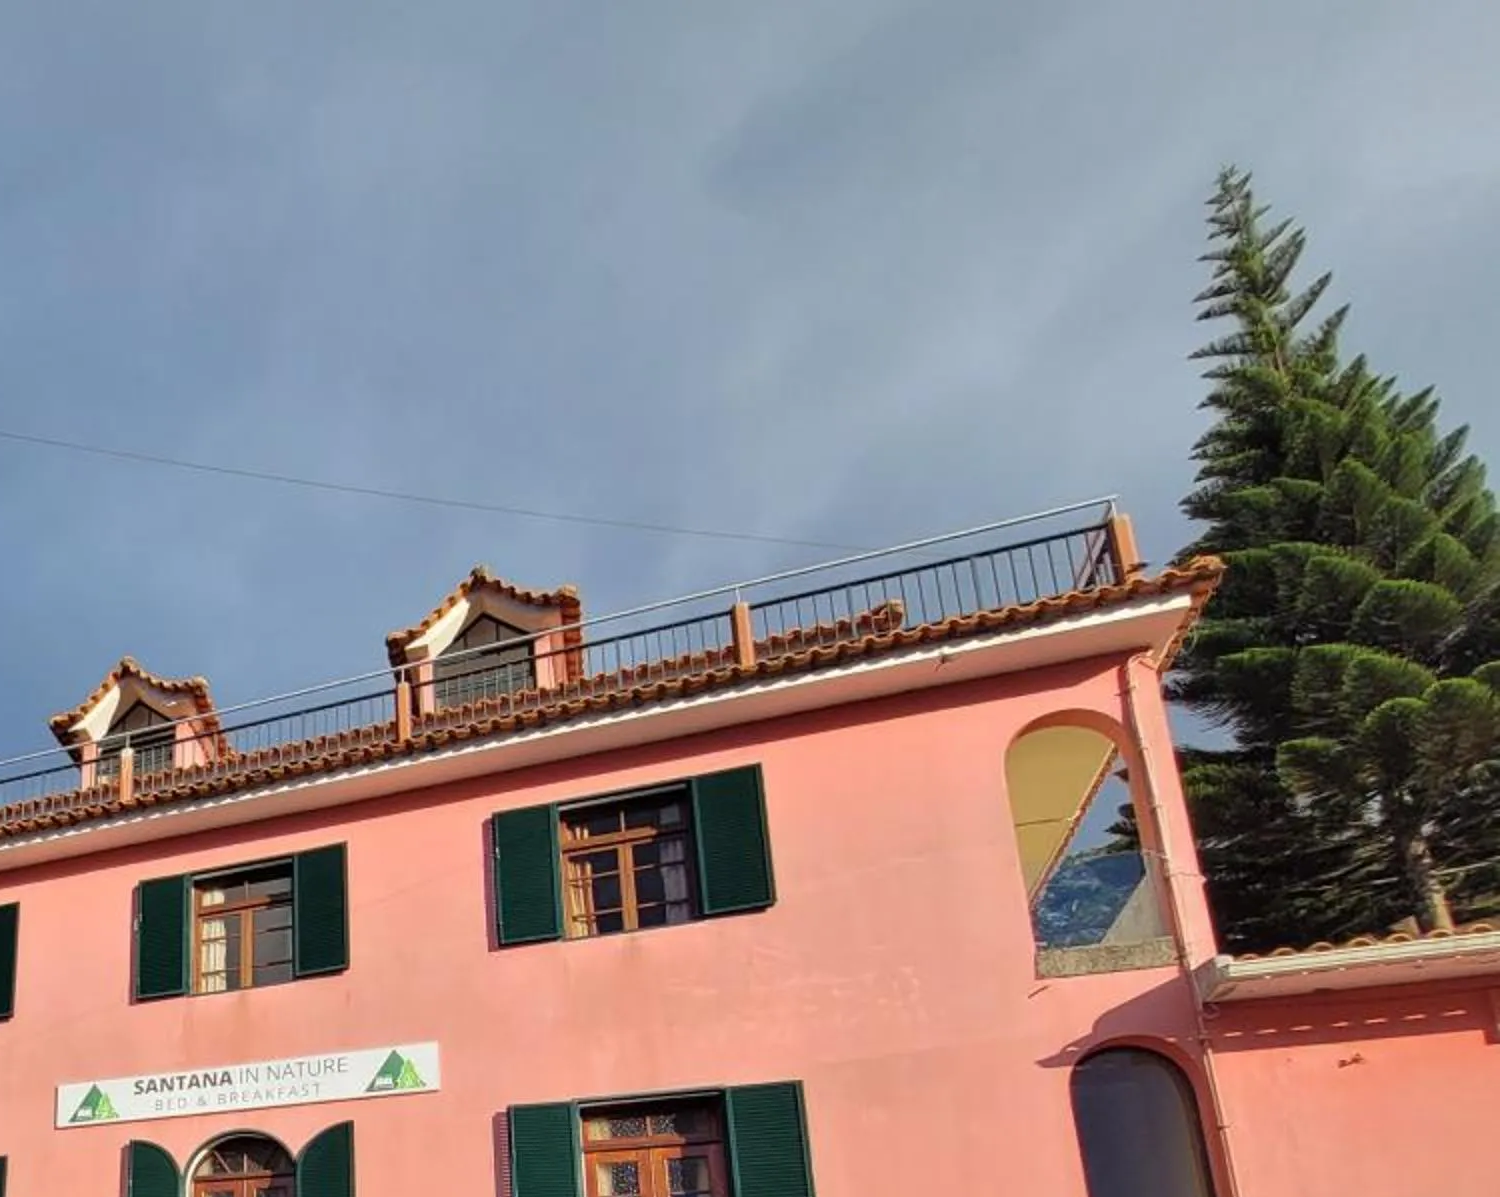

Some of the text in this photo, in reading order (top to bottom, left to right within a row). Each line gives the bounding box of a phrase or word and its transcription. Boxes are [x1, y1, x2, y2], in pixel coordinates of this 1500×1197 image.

[133, 1056, 349, 1095] SANTANA IN NATURE
[155, 1083, 321, 1111] BED & BREAKFAST
